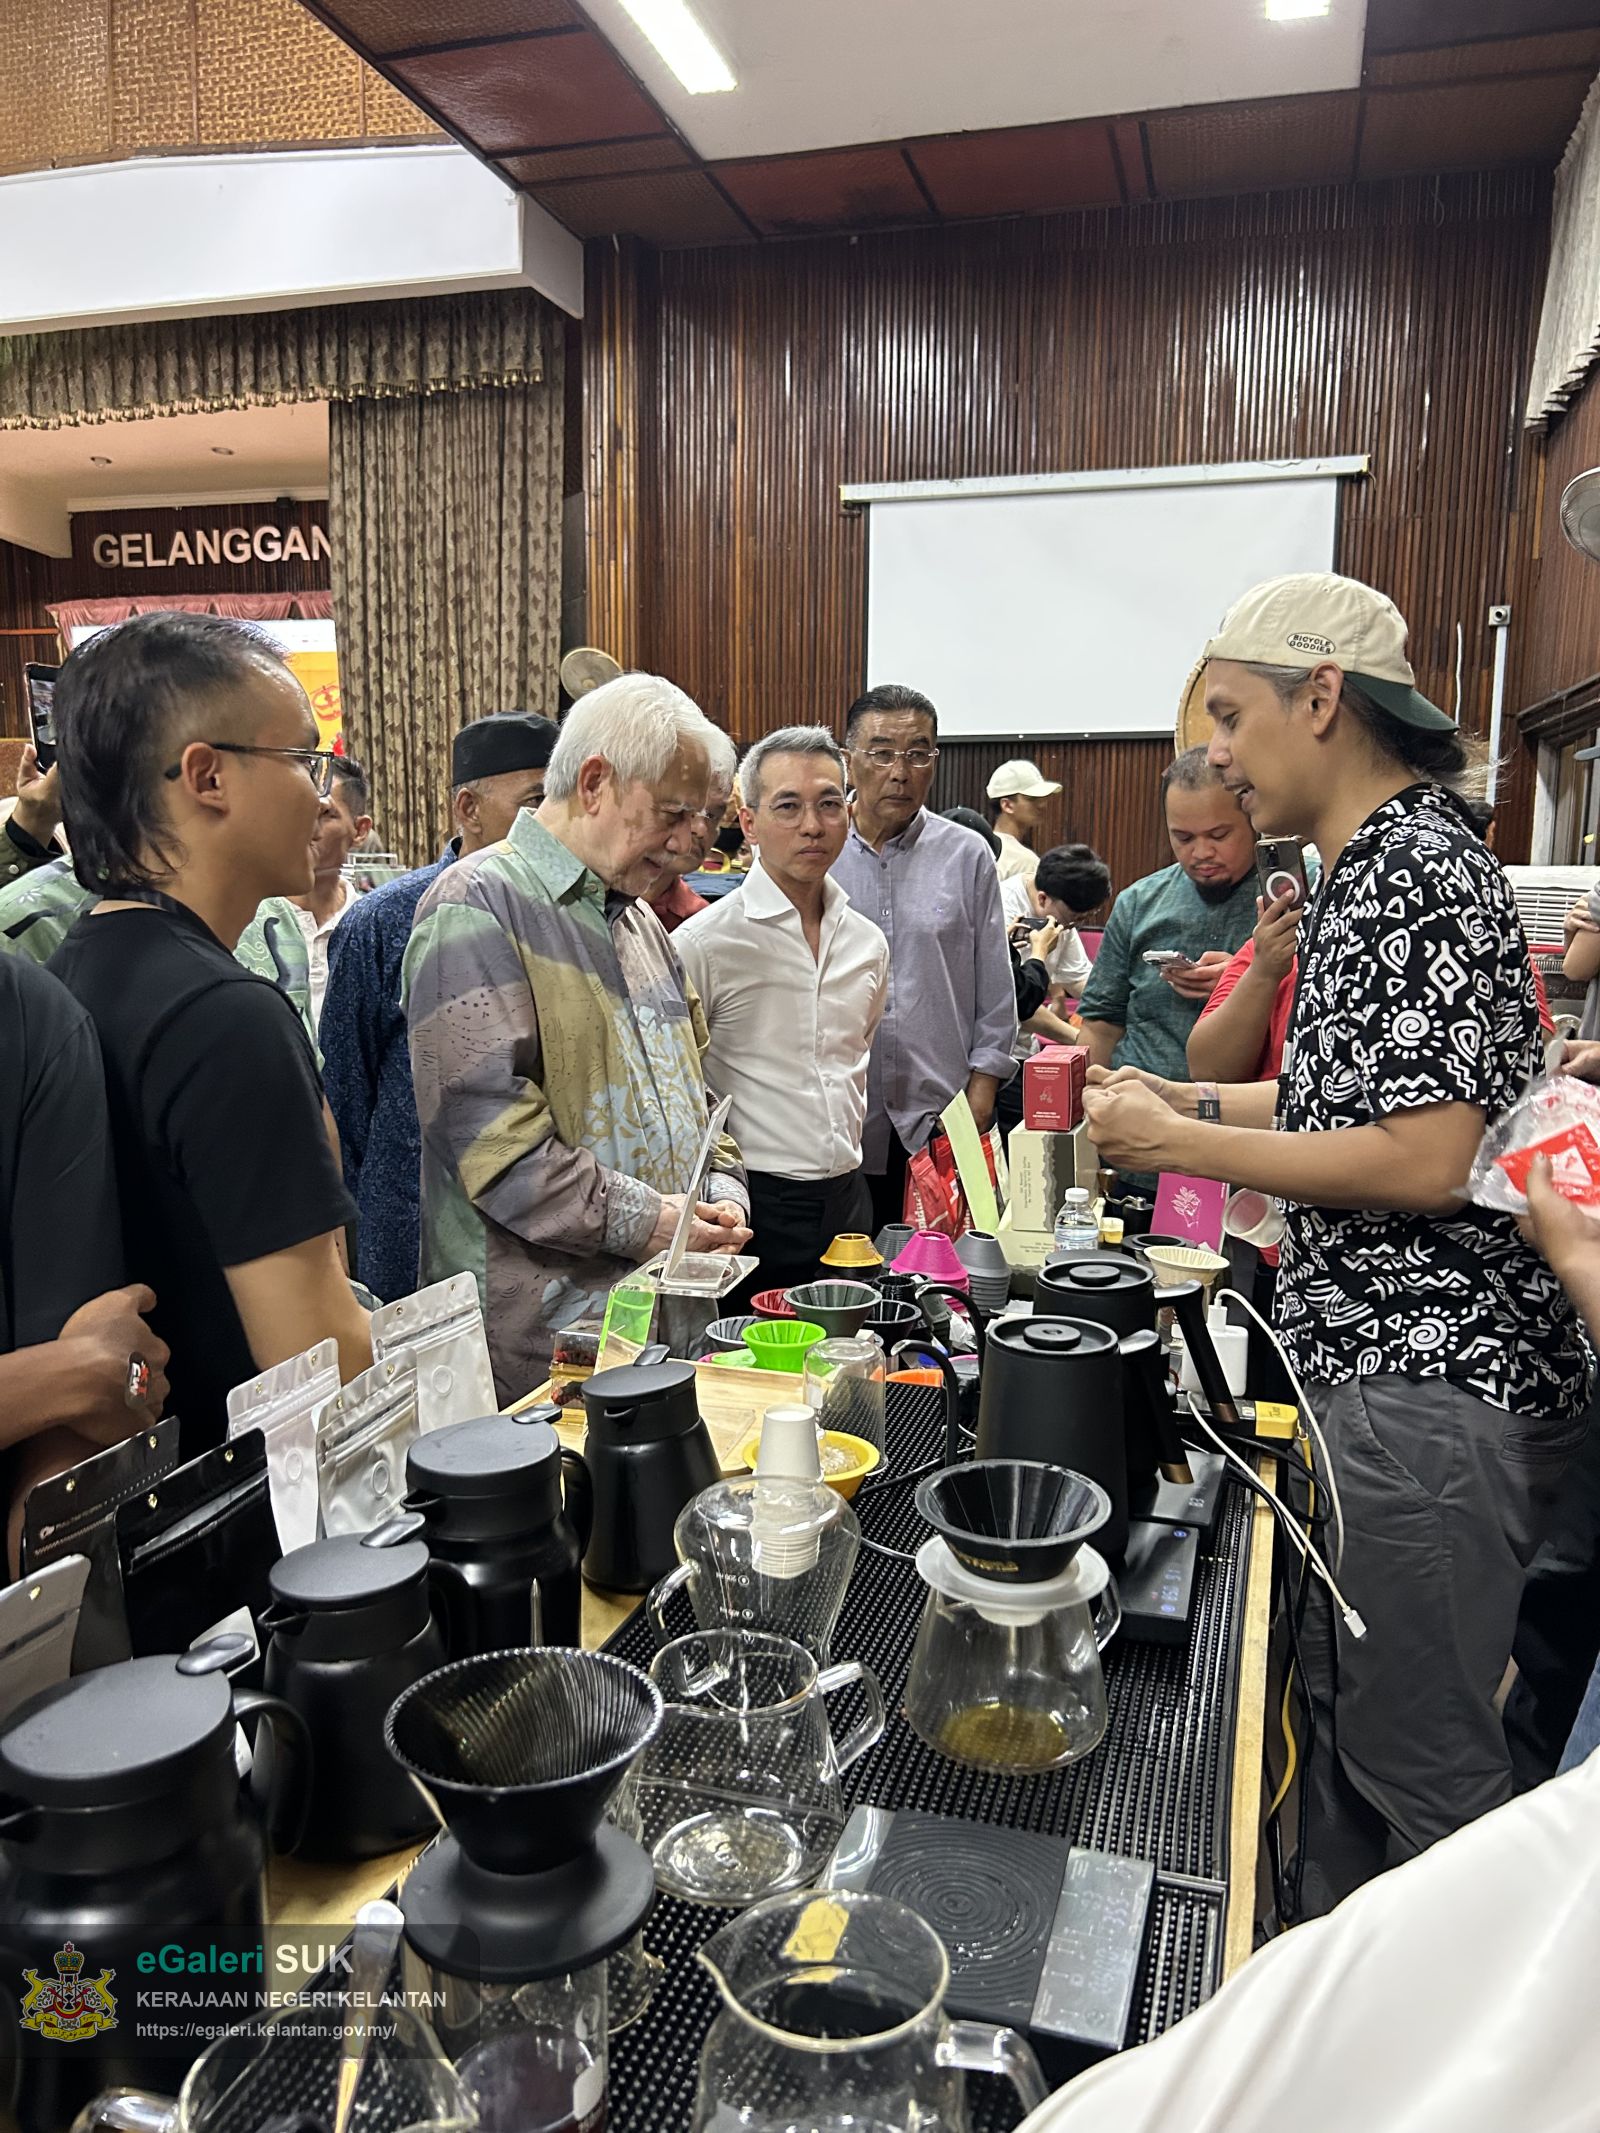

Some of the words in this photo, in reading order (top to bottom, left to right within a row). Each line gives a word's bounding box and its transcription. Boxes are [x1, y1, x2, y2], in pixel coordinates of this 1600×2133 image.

[93, 525, 331, 568] GELANGGAN
[1289, 640, 1331, 654] GOODIES
[1293, 634, 1331, 647] BICYCLE
